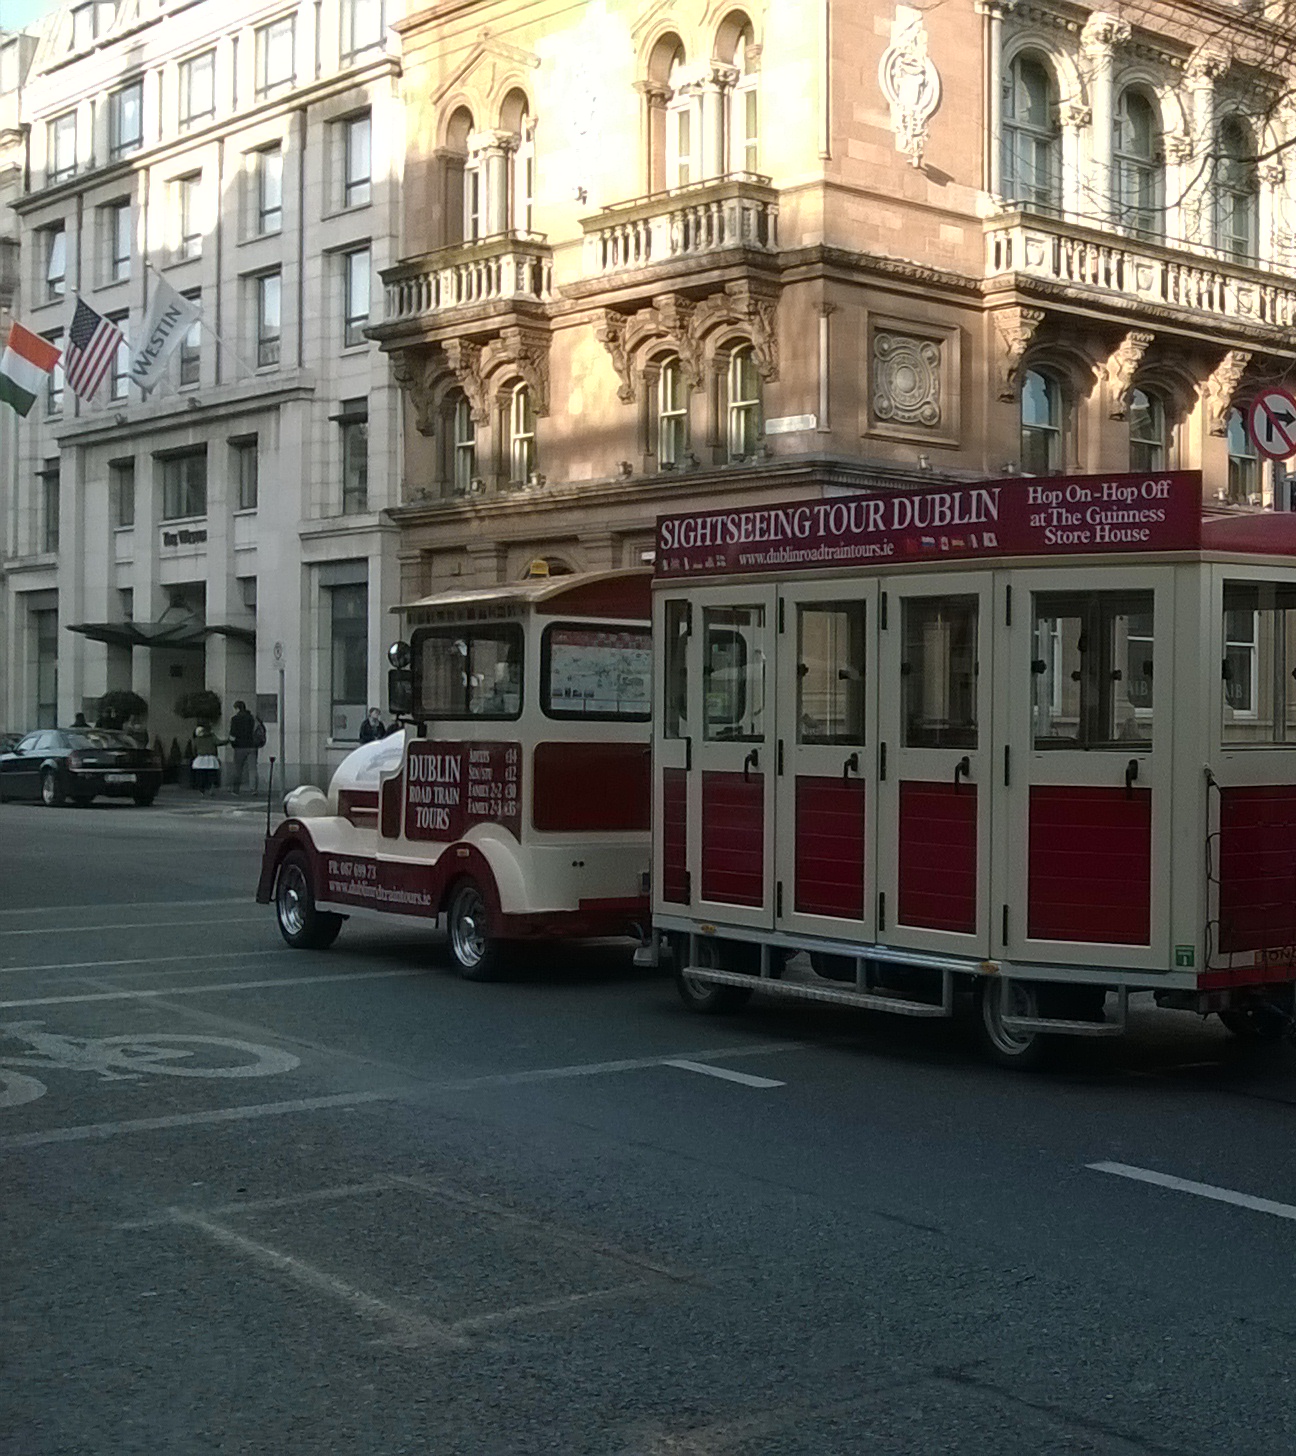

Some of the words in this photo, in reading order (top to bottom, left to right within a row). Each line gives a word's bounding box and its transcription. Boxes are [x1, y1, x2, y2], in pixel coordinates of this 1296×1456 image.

[133, 303, 182, 375] WESTIN
[1027, 486, 1063, 507] Hop
[1141, 480, 1172, 499] Off
[660, 507, 812, 549] SIGHTSEEING
[814, 500, 886, 537] TOUR
[891, 488, 1001, 530] DUBLIN
[1030, 514, 1047, 527] at
[1048, 508, 1082, 526] The
[1086, 505, 1166, 525] Guinness
[1044, 527, 1091, 545] Store
[1095, 525, 1151, 543] House
[739, 538, 894, 566] www.dublinroadtraintours.ie
[409, 754, 462, 783] DUBLIN
[409, 785, 432, 803] ROAD
[433, 786, 460, 805] TRAIN
[415, 806, 451, 830] TOURS
